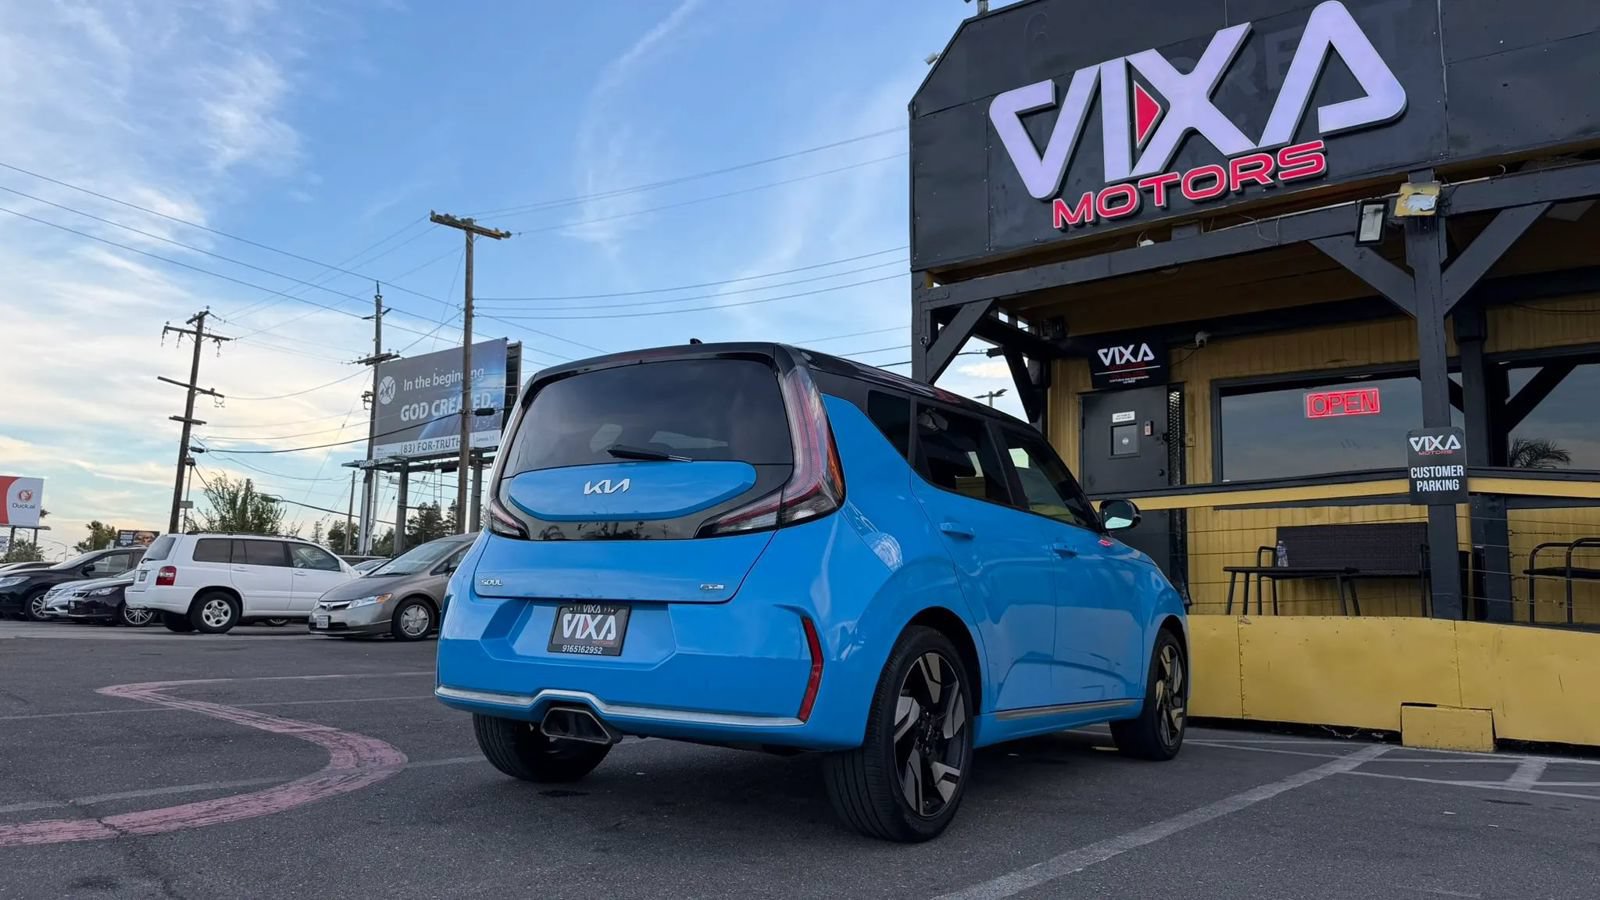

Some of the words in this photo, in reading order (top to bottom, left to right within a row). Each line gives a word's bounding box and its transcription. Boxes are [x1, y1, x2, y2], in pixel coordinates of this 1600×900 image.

[989, 0, 1408, 200] VIXA
[1052, 139, 1327, 229] MOTORS
[1097, 342, 1155, 367] VIXA
[403, 379, 413, 392] In
[415, 375, 431, 389] the
[400, 401, 428, 421] GOD
[1311, 391, 1377, 415] OPEN
[400, 443, 415, 455] (83)
[1408, 434, 1462, 452] VIXA
[1410, 465, 1464, 479] CUSTOMER
[583, 478, 631, 495] KIA
[1416, 479, 1460, 492] PARKING
[480, 578, 503, 587] SOUL
[583, 604, 601, 614] VIXA
[562, 613, 617, 641] VIXA
[562, 644, 604, 655] 9165162952
